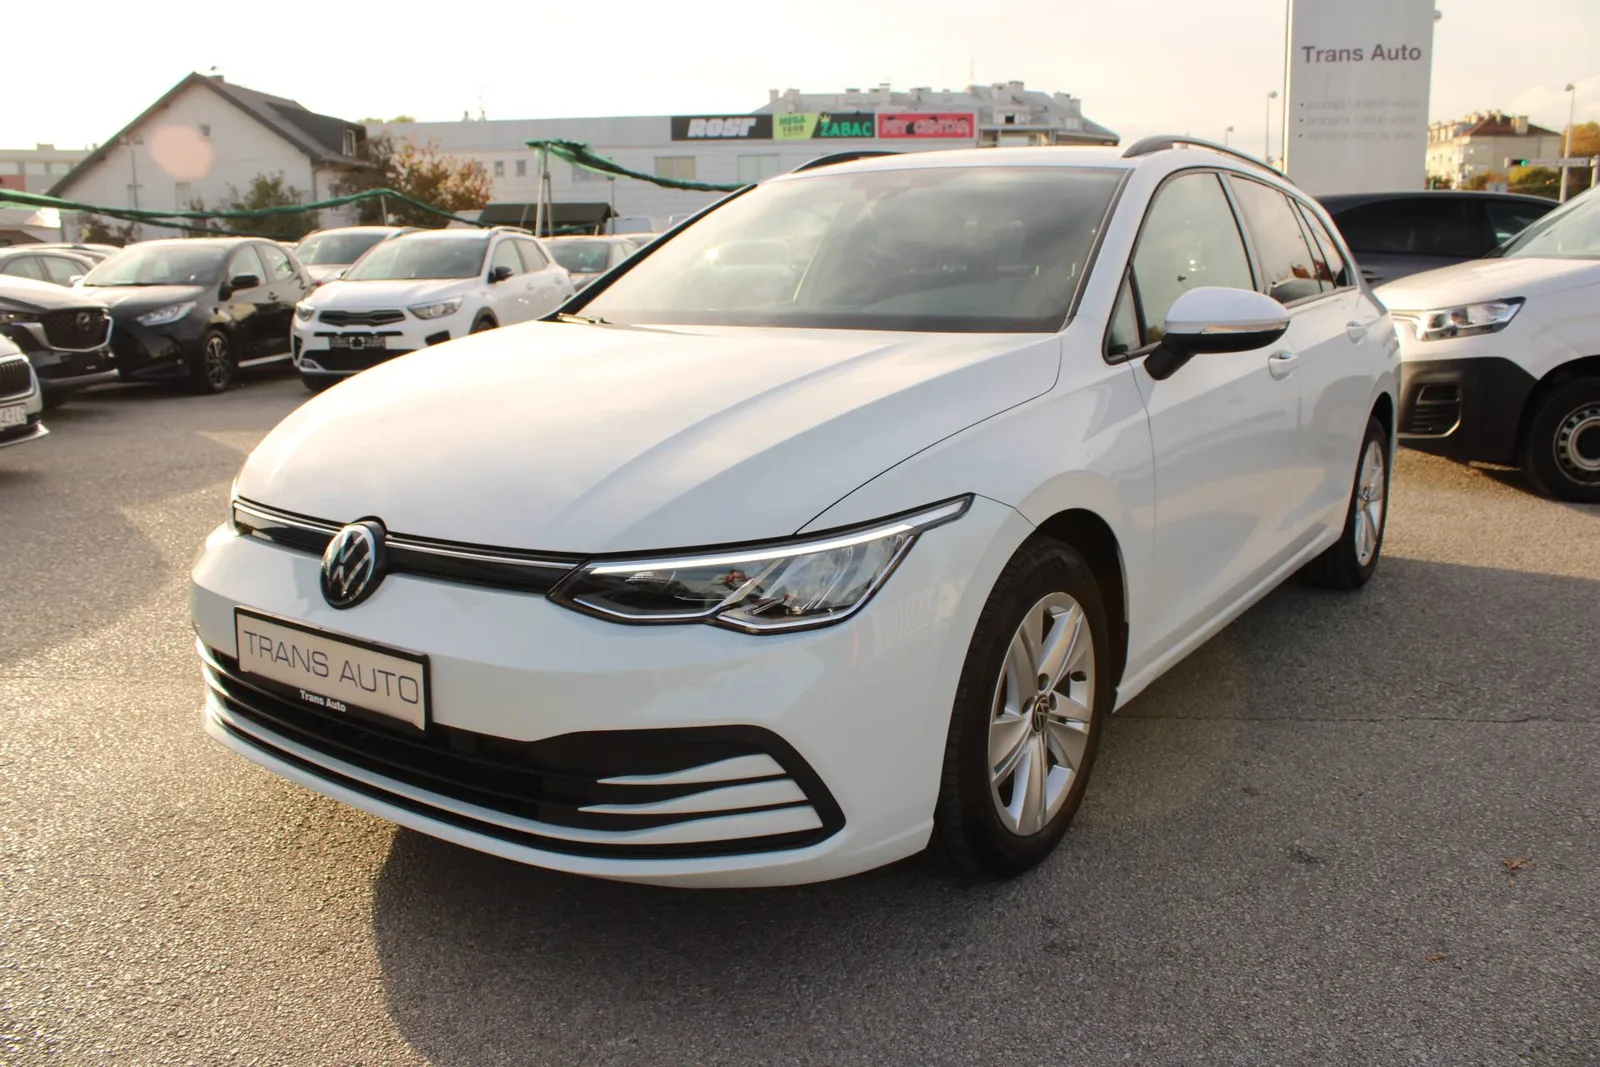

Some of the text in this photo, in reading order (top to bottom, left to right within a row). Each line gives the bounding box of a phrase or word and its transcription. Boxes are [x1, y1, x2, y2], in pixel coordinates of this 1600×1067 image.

[1301, 43, 1422, 63] Trans Auto
[687, 117, 757, 138] ROST
[243, 630, 420, 705] TRANS AUTO
[300, 689, 347, 712] Trans Auto
